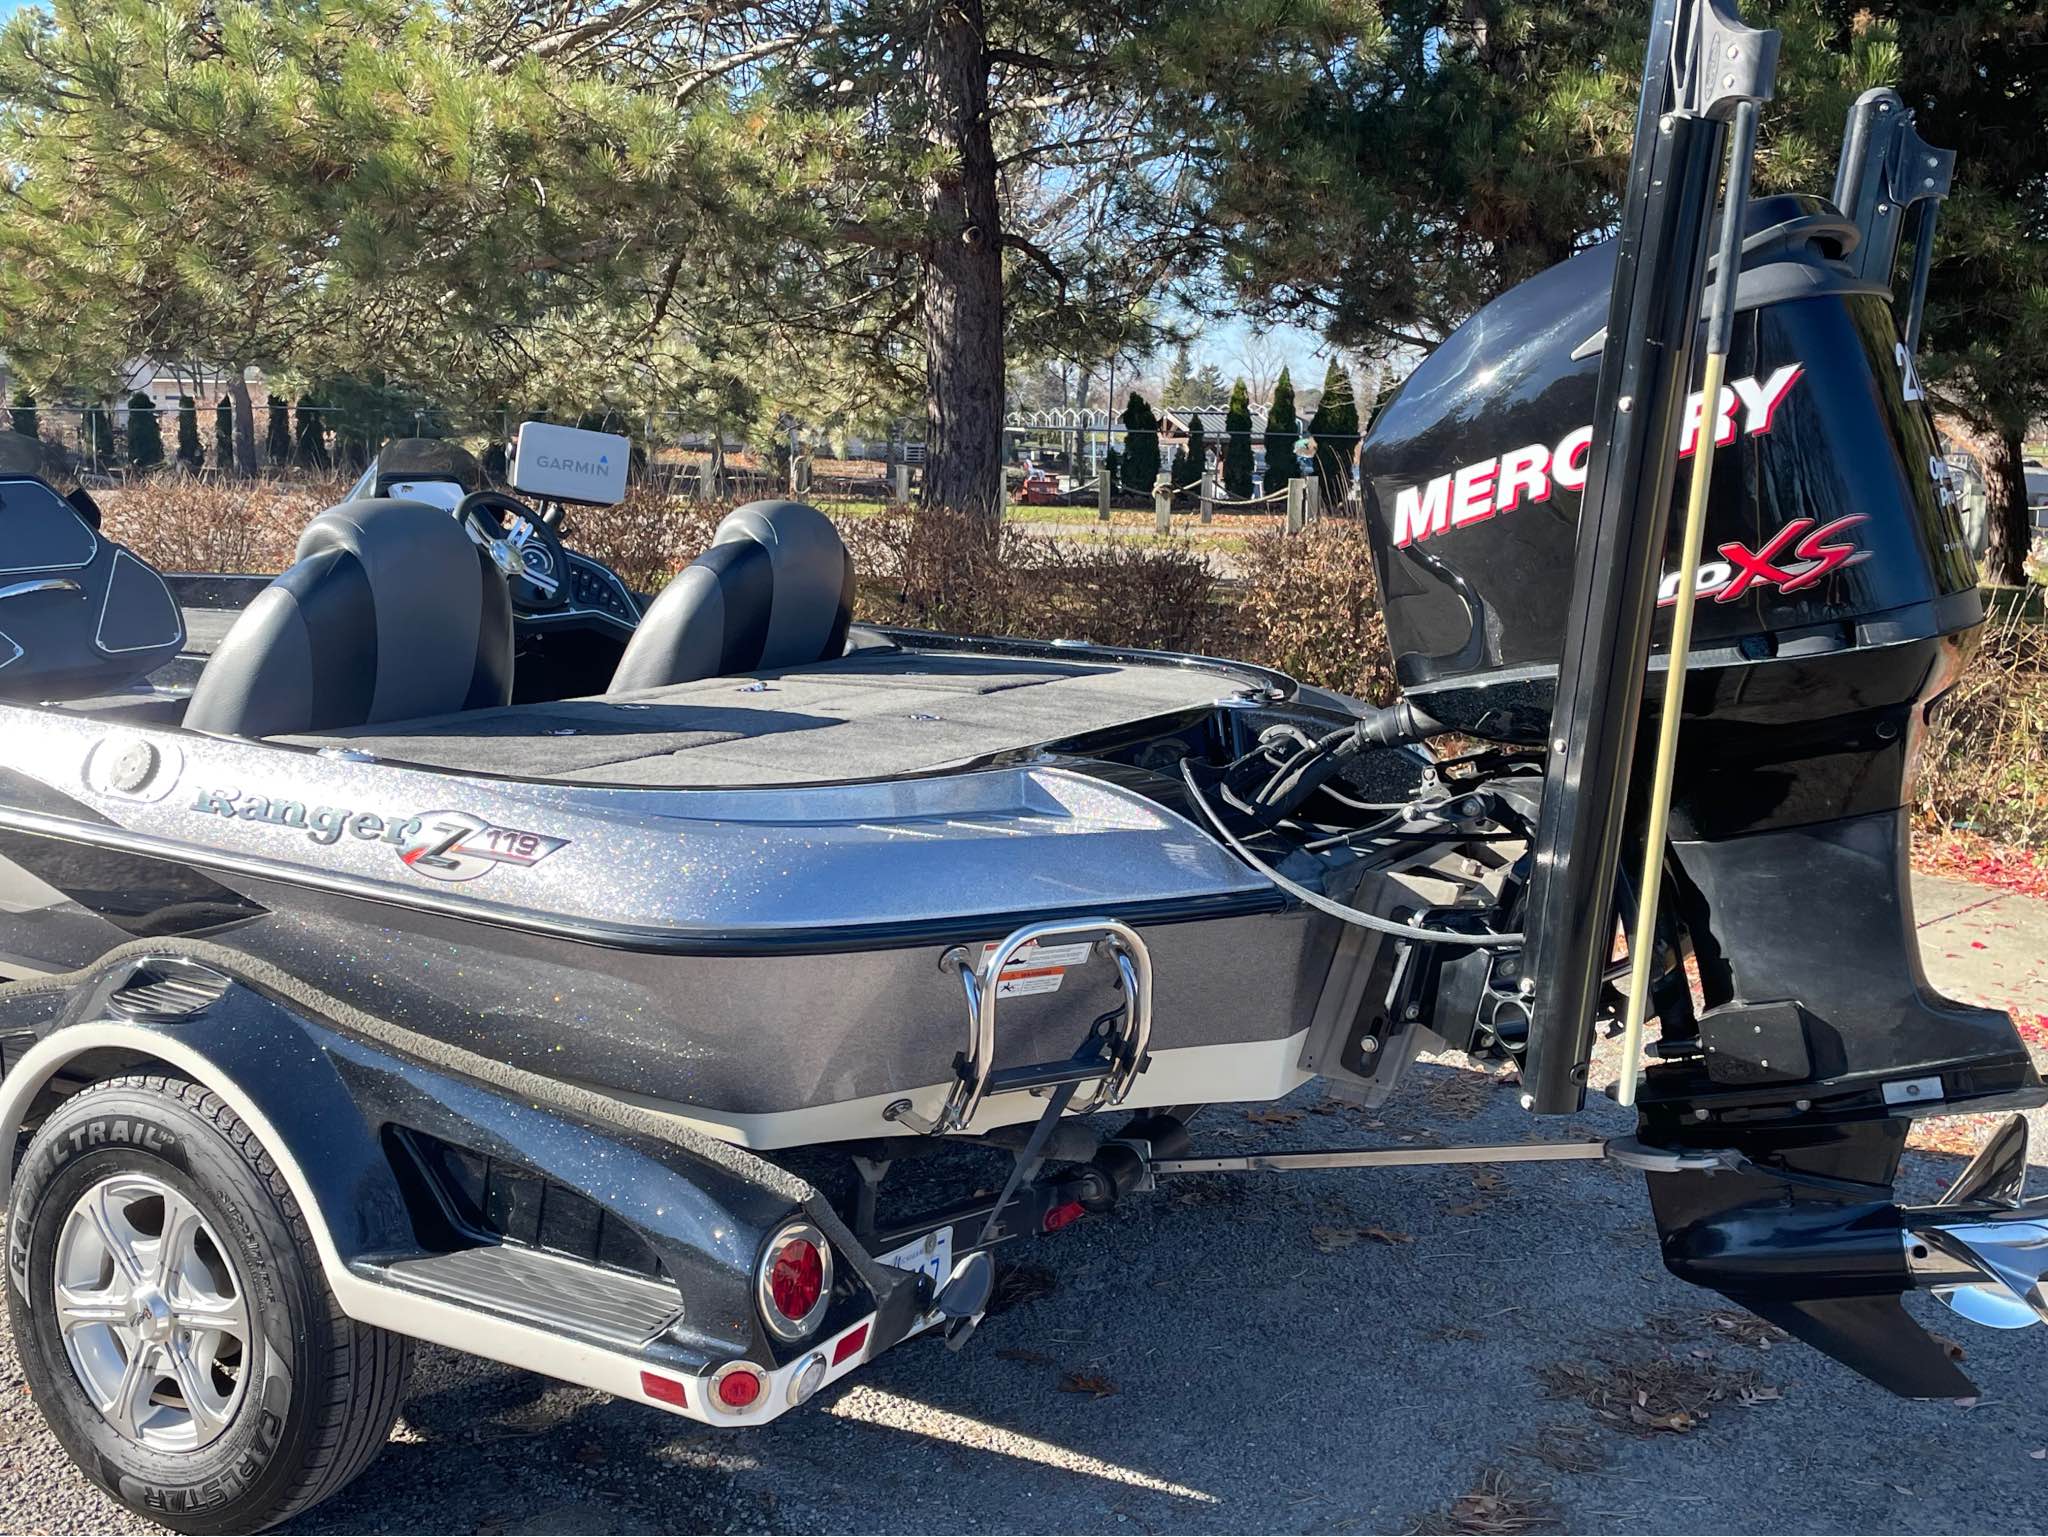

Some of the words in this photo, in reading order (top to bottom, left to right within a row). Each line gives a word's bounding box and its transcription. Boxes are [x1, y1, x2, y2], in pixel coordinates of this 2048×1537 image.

[536, 455, 609, 477] GARMIN
[1393, 361, 1806, 549] MERCRY
[190, 785, 423, 845] Ranger
[485, 829, 540, 856] 119
[68, 1119, 164, 1152] TRAIL
